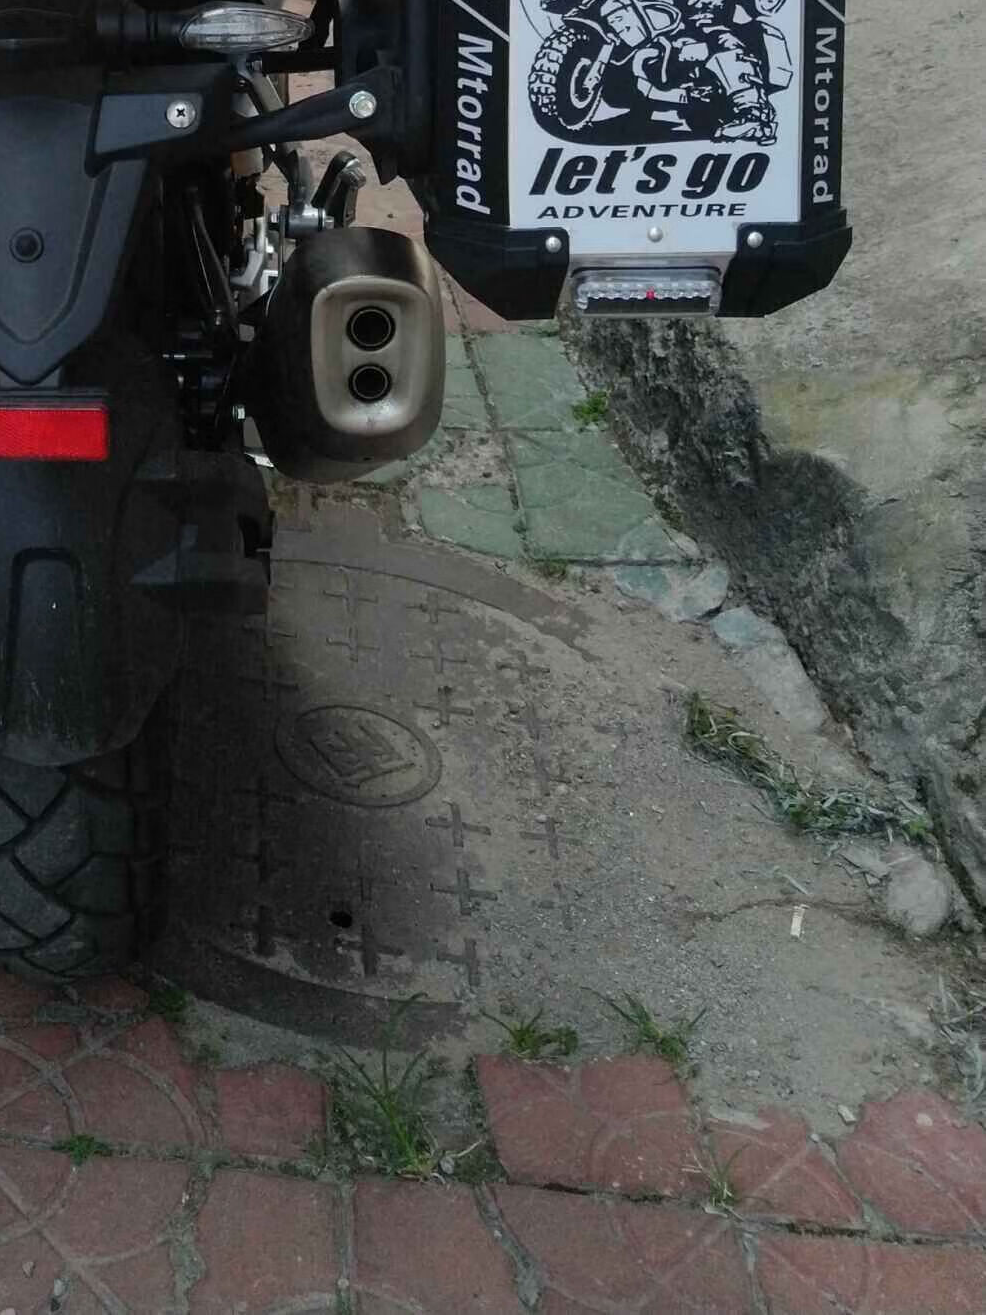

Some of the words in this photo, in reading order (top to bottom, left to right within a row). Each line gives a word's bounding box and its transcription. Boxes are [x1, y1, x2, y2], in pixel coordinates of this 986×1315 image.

[529, 146, 678, 196] let's
[682, 152, 771, 200] go
[537, 203, 748, 220] ADVENTURE
